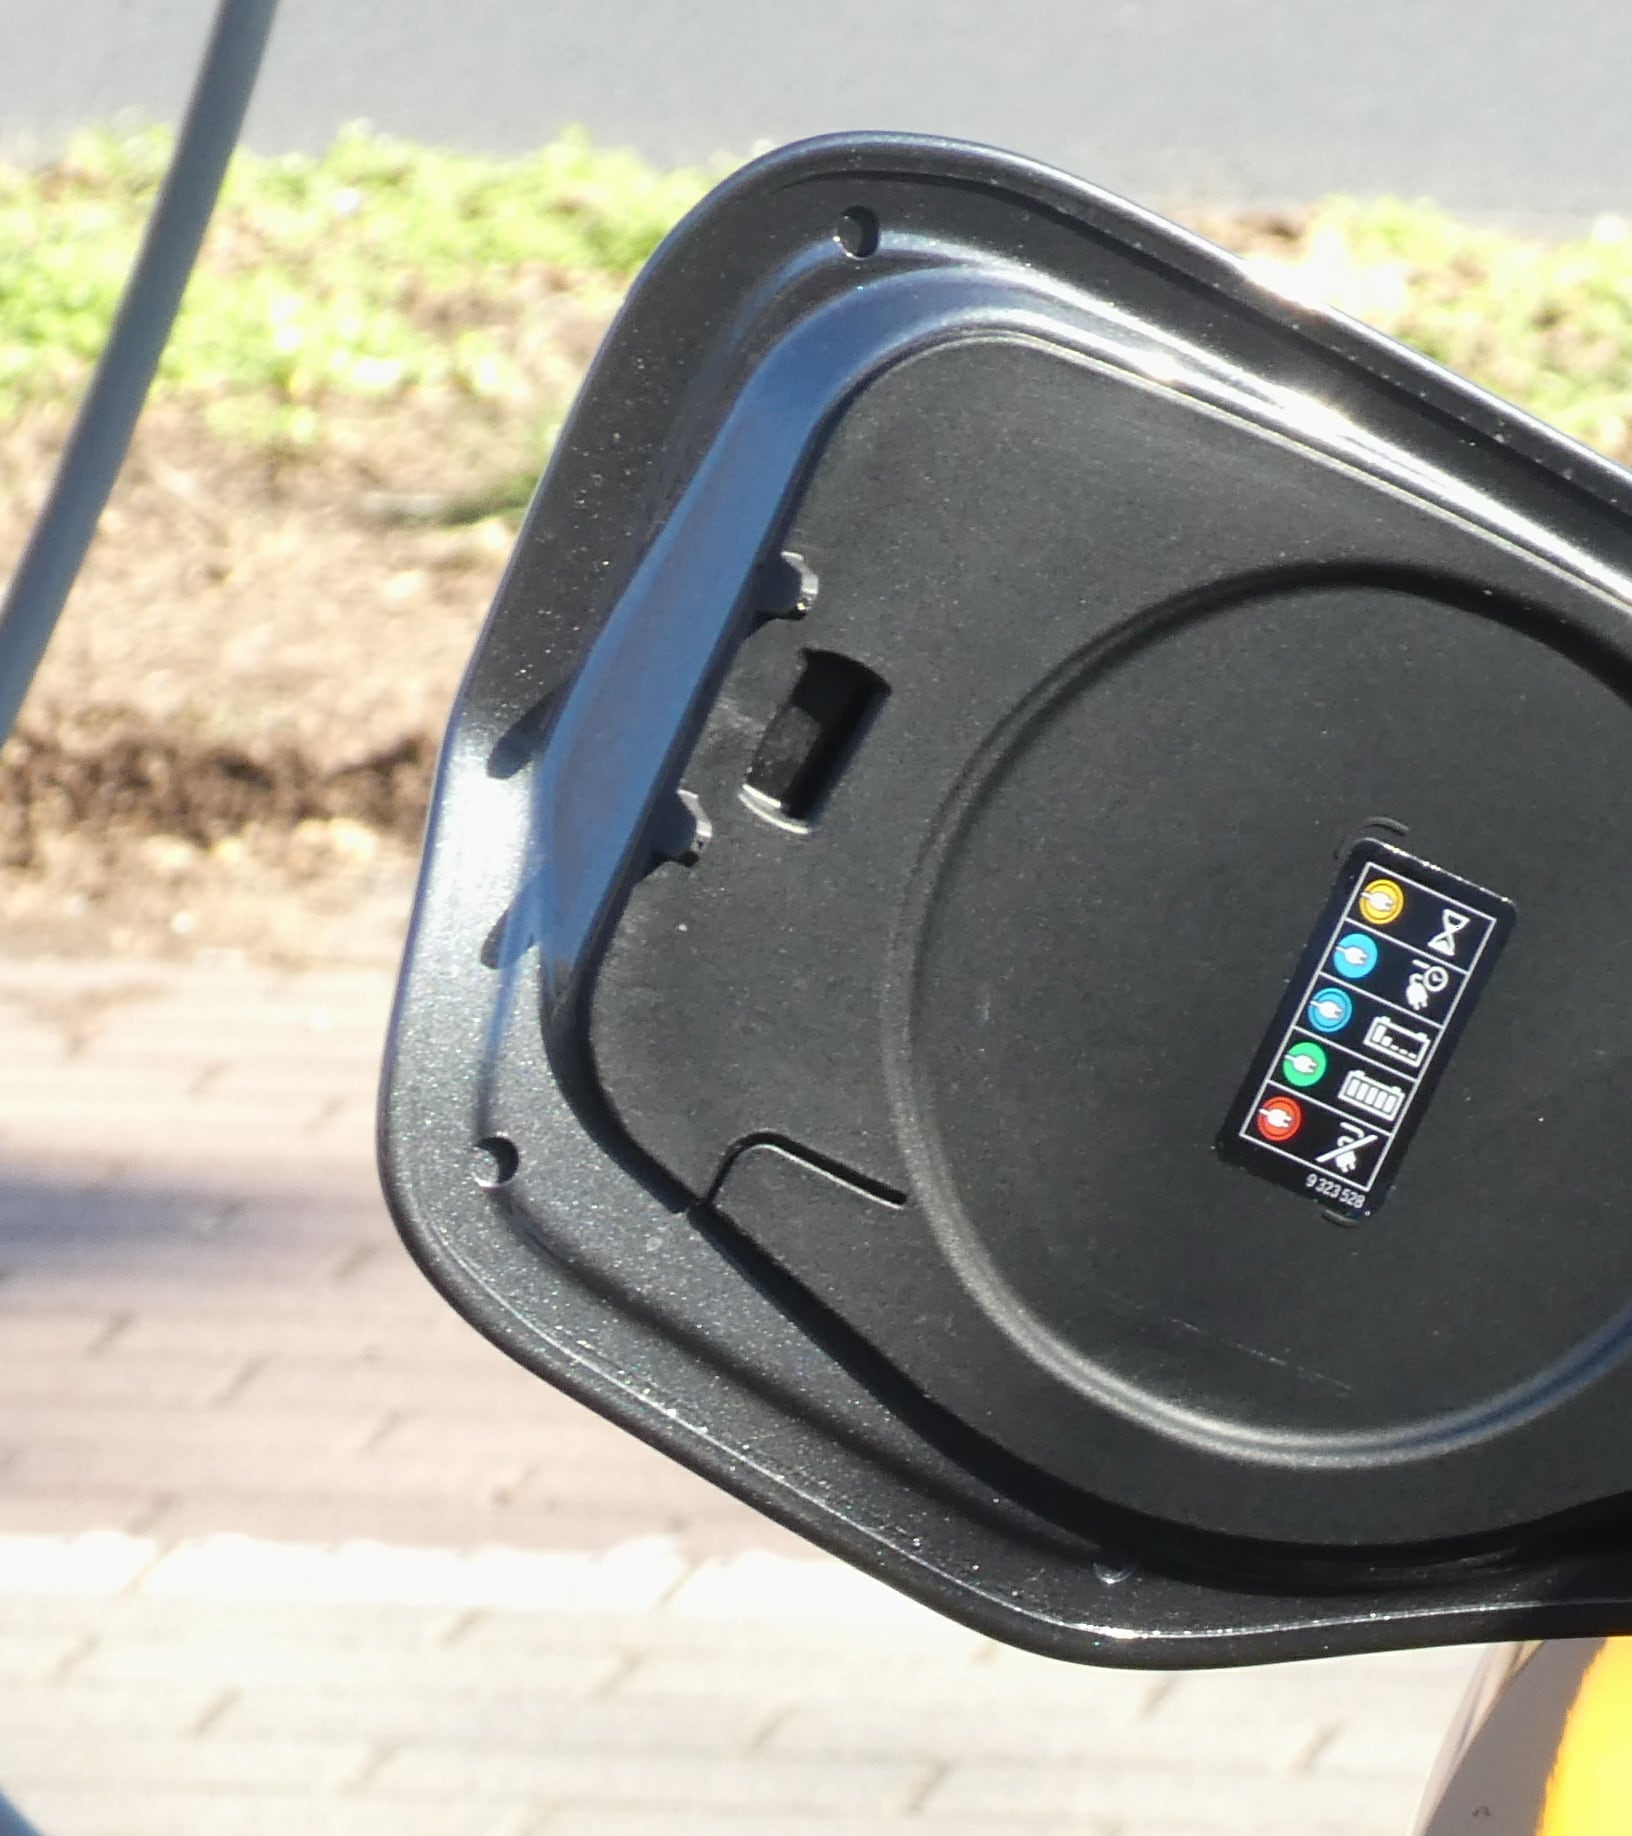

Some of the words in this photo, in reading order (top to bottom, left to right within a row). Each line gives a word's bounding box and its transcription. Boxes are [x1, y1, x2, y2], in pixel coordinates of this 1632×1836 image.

[1306, 1173, 1318, 1188] 9
[1315, 1178, 1341, 1198] 323
[1339, 1188, 1366, 1209] 528
